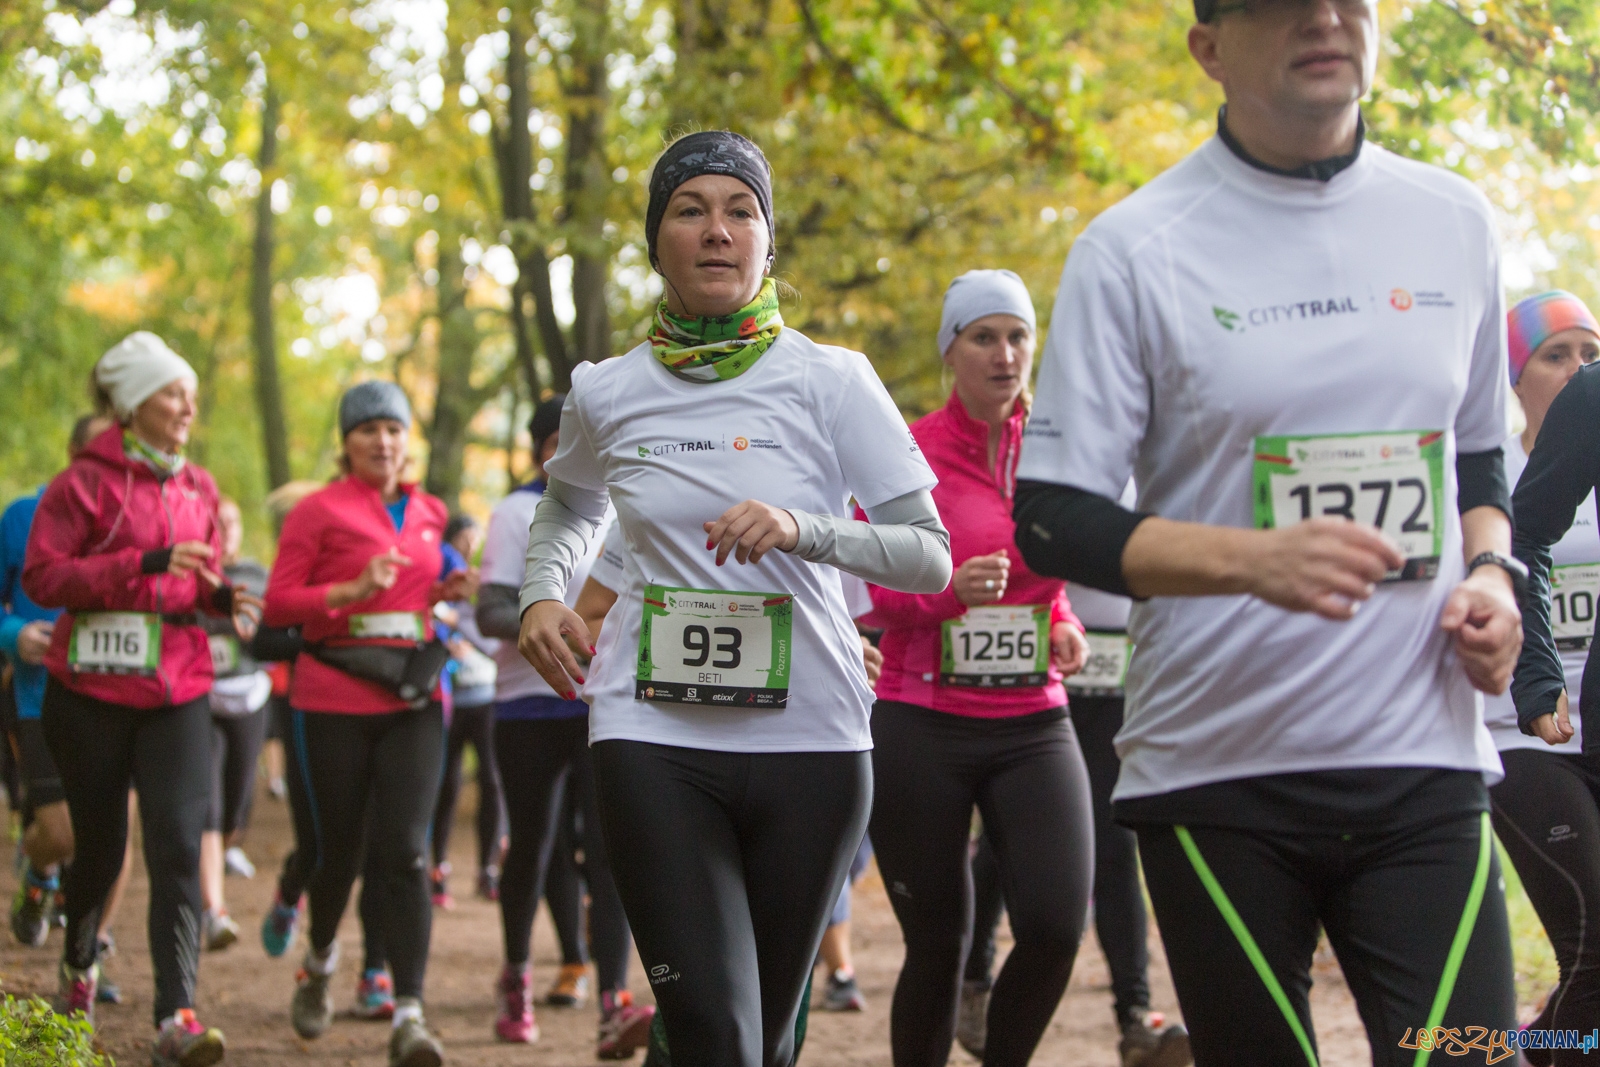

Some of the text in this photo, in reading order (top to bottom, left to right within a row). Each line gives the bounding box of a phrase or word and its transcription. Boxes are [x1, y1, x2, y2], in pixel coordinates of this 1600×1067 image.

[1289, 478, 1429, 533] 1372
[1552, 590, 1594, 624] 10
[92, 630, 139, 655] 1116
[682, 624, 743, 669] 93
[775, 639, 786, 677] Poznań
[959, 631, 1035, 661] 1256
[698, 672, 722, 684] BETI
